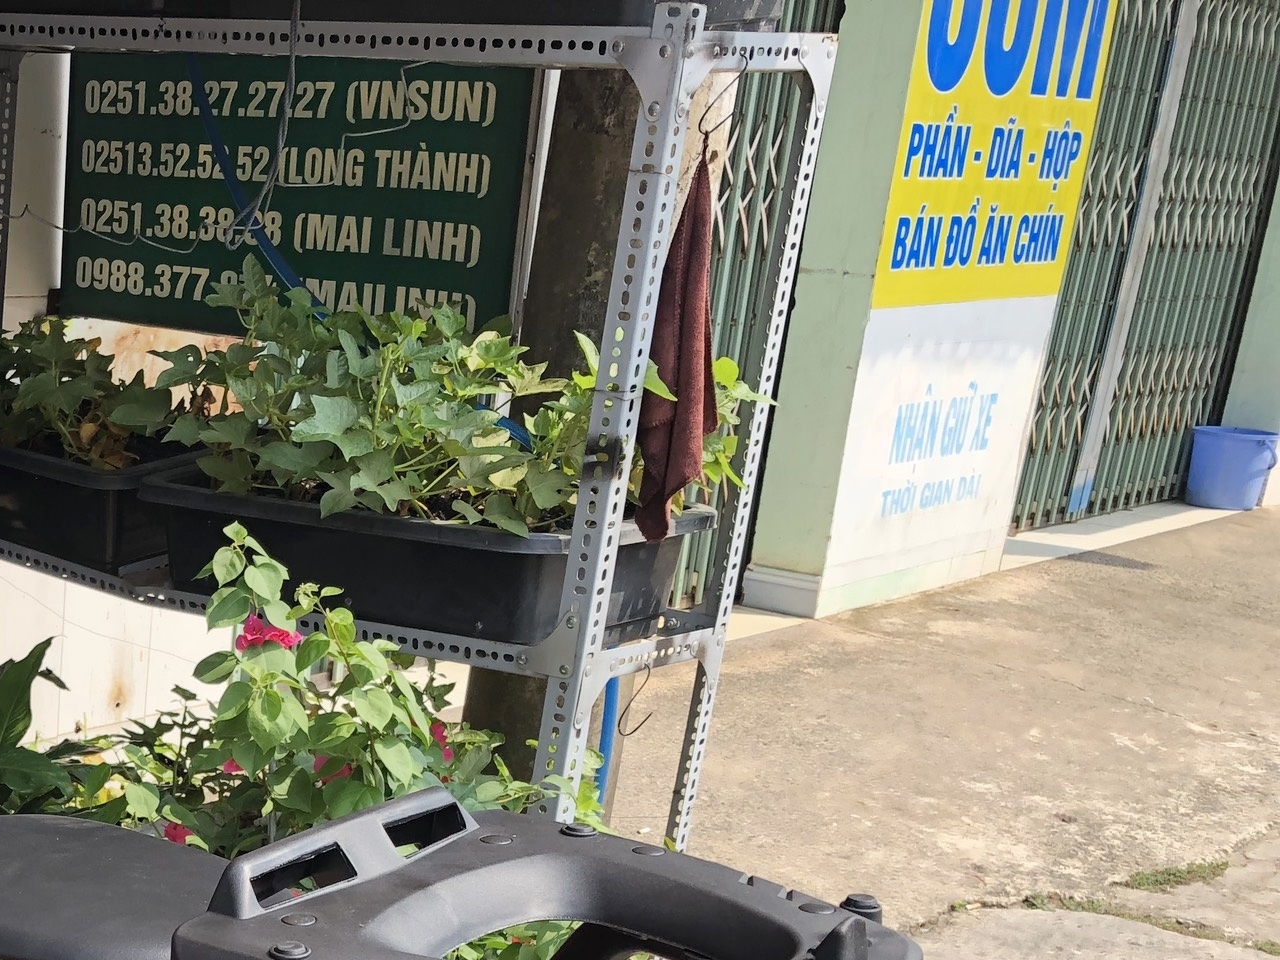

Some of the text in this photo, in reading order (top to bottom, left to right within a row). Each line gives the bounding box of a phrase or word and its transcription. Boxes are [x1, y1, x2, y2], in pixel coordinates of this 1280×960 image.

[84, 79, 497, 127] 0251.38.27.27.27 (VNSUN)
[81, 139, 491, 199] 02513.52.552 (LONG THÀNH)
[985, 117, 1024, 179] DĨA
[1038, 120, 1082, 190] HỘP
[293, 212, 373, 254] (MAI
[382, 217, 481, 268] LINH)
[890, 204, 943, 269] BÁN
[976, 204, 1013, 265] ĂN
[1013, 203, 1064, 264] CHÍN
[969, 393, 998, 452] XE
[919, 478, 954, 509] GIAN
